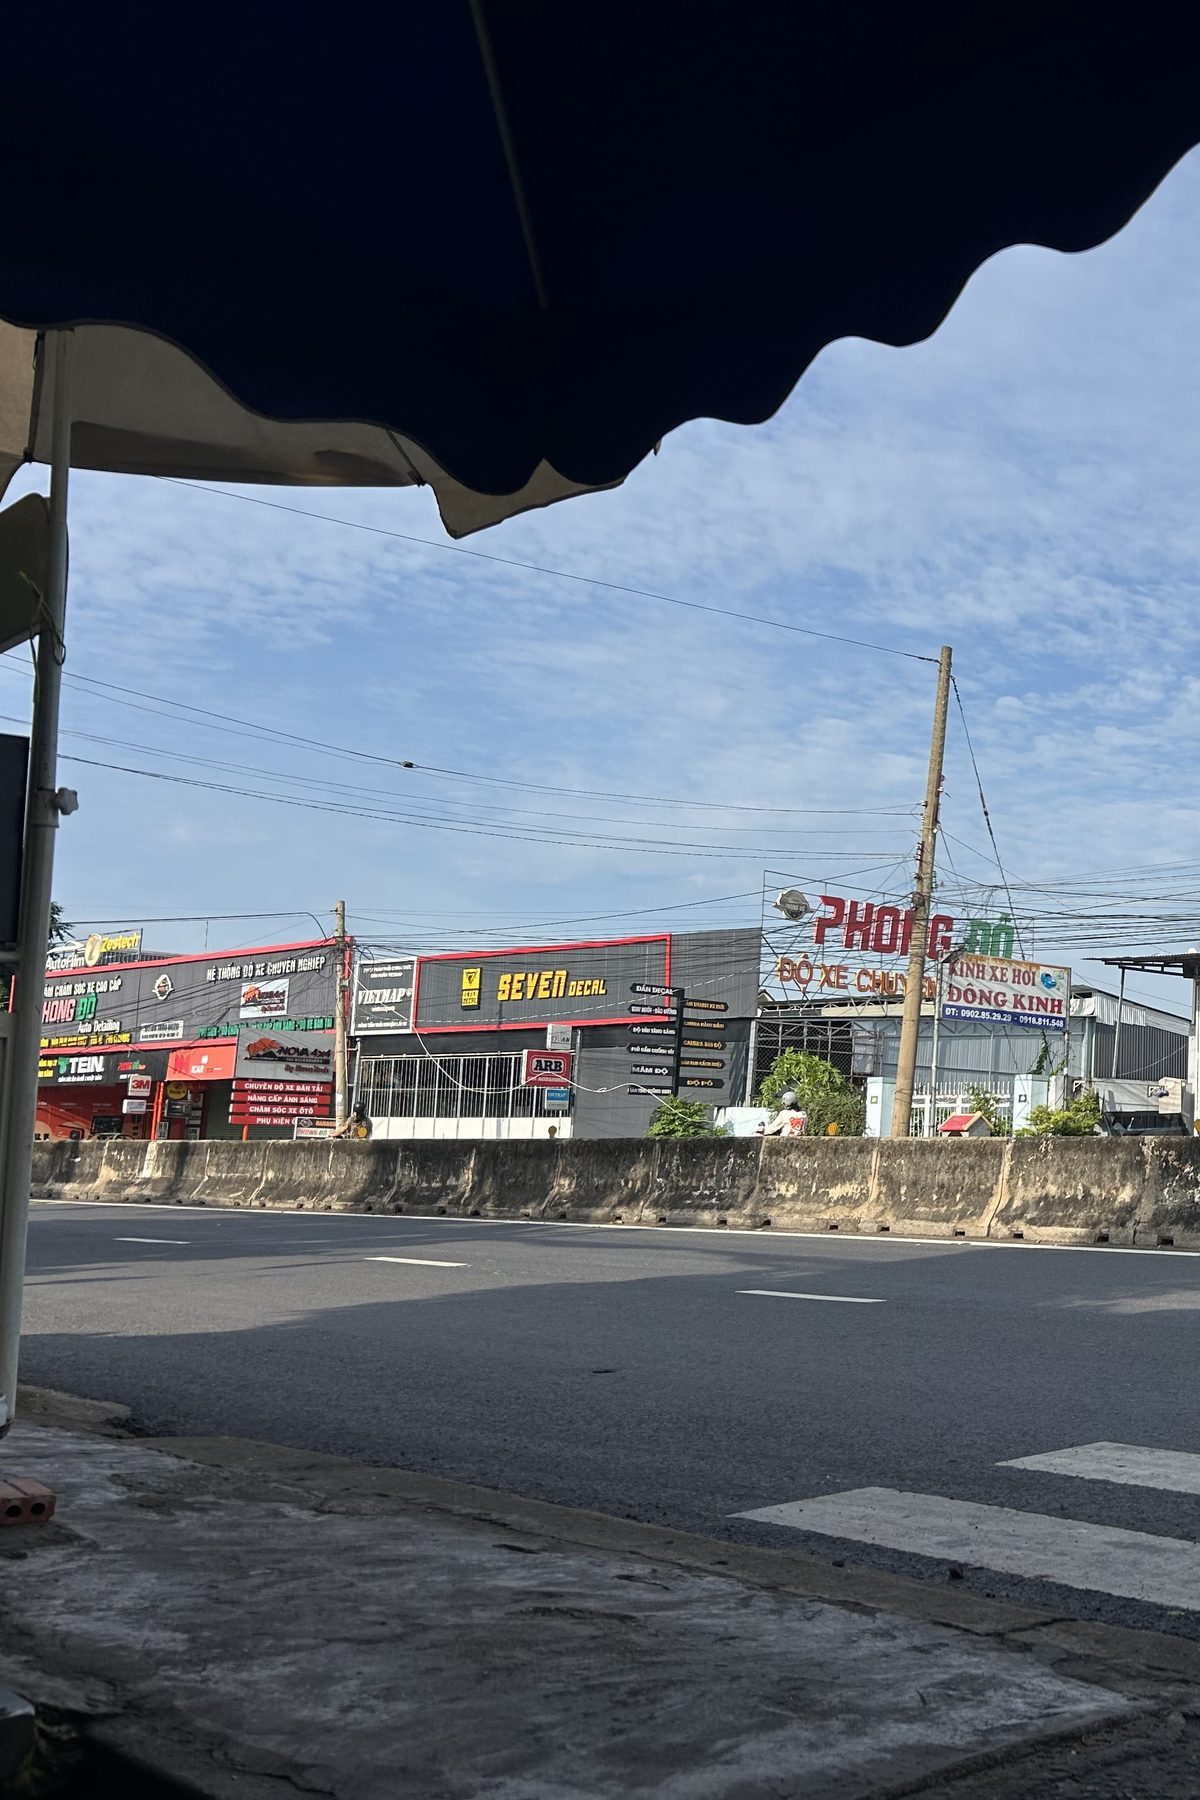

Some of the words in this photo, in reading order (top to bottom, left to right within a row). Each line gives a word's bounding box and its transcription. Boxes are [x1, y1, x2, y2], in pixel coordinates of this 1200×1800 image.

[100, 933, 141, 952] Zestech
[255, 963, 266, 976] XE
[989, 965, 1009, 982] XE
[44, 984, 54, 997] ÂM
[87, 981, 96, 994] XE
[497, 970, 568, 1001] SEVEN
[568, 979, 607, 996] DECAL
[819, 963, 848, 989] XE
[855, 968, 937, 999] CHUYN
[358, 988, 407, 1005] VIETMAP
[947, 983, 1008, 1008] ĐÔNG
[1012, 994, 1063, 1014] KINH
[42, 998, 76, 1023] HONG
[945, 1007, 958, 1017] ĐT:
[961, 1009, 1012, 1022] 0902.85.29.29
[1019, 1015, 1063, 1028] 0918.811.548
[78, 1021, 92, 1033] Auto
[551, 1035, 570, 1043] TIAN
[276, 1046, 309, 1056] NOVA
[310, 1048, 331, 1057] 4x4
[534, 1059, 563, 1073] ARB
[131, 1080, 150, 1090] 3M
[244, 1081, 273, 1090] CHUYÊN
[274, 1083, 284, 1092] ĐỘ
[272, 1104, 286, 1114] SÓC
[288, 1106, 298, 1114] XE
